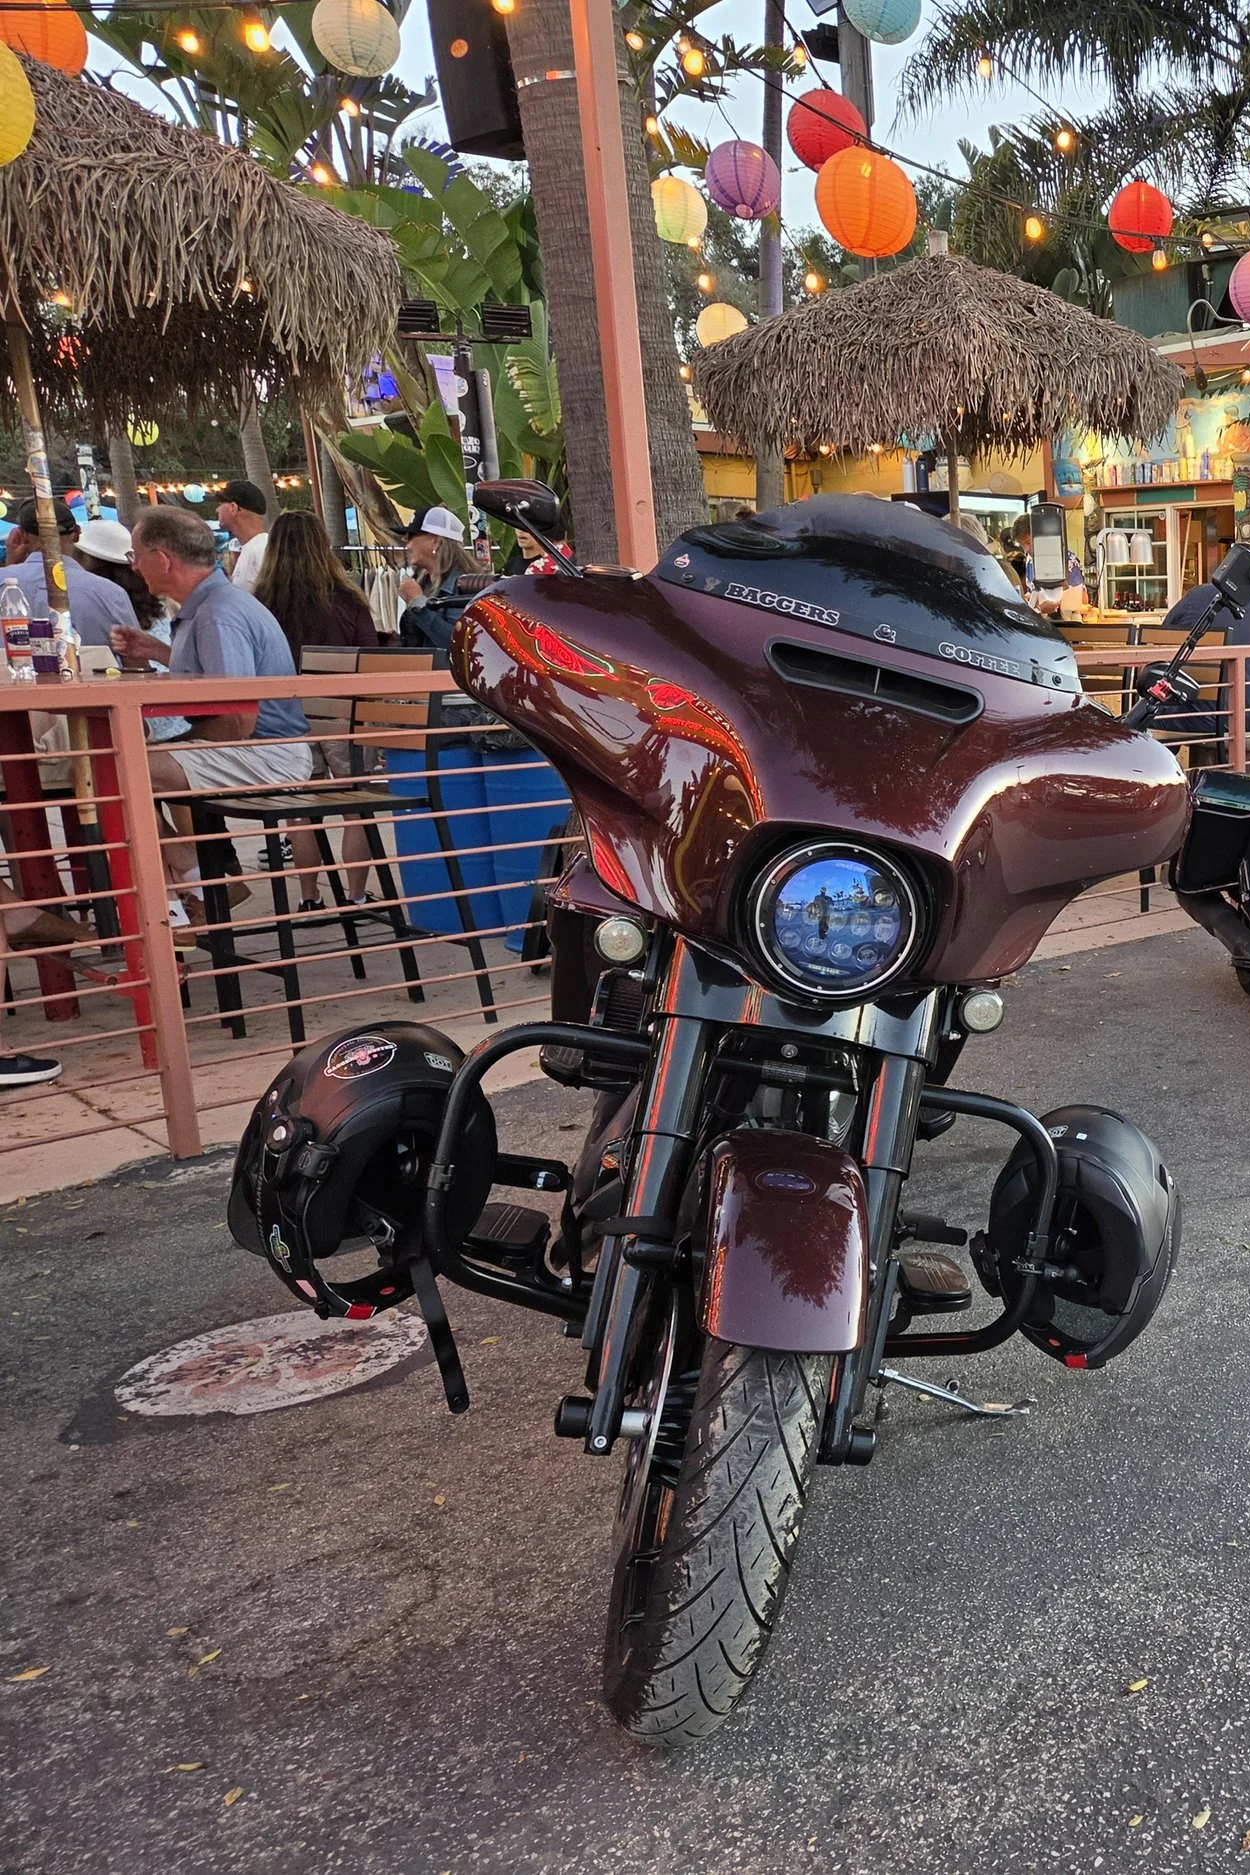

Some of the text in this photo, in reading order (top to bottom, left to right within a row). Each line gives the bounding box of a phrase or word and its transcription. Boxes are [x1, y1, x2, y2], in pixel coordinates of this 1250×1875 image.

[724, 582, 1020, 677] BAGGERS & COFFEE
